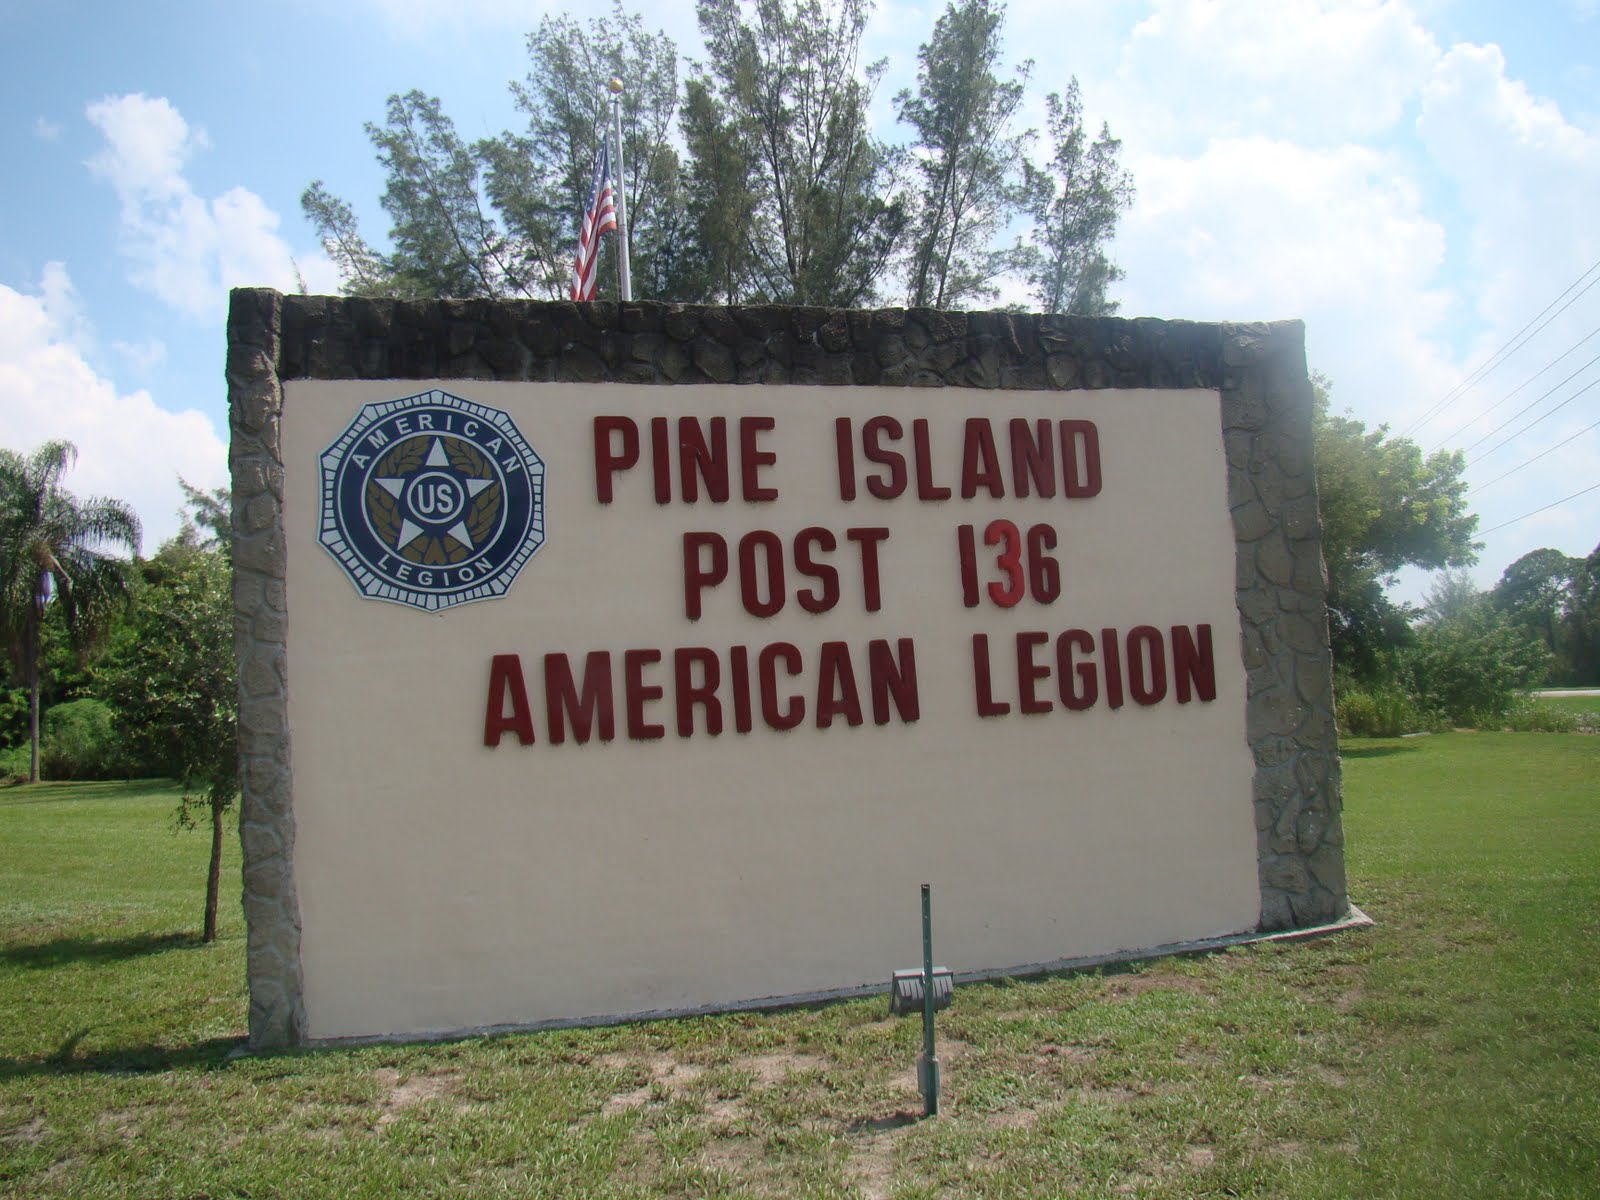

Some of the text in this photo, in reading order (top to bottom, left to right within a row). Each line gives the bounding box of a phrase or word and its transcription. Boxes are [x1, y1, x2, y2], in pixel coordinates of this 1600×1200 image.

[352, 413, 521, 474] AMERICAN
[594, 415, 1103, 504] PINE ISLAND
[418, 484, 454, 515] US
[378, 553, 494, 587] LEGION
[683, 519, 1061, 620] POST 136
[484, 623, 1217, 747] AMERICAN LEGION
